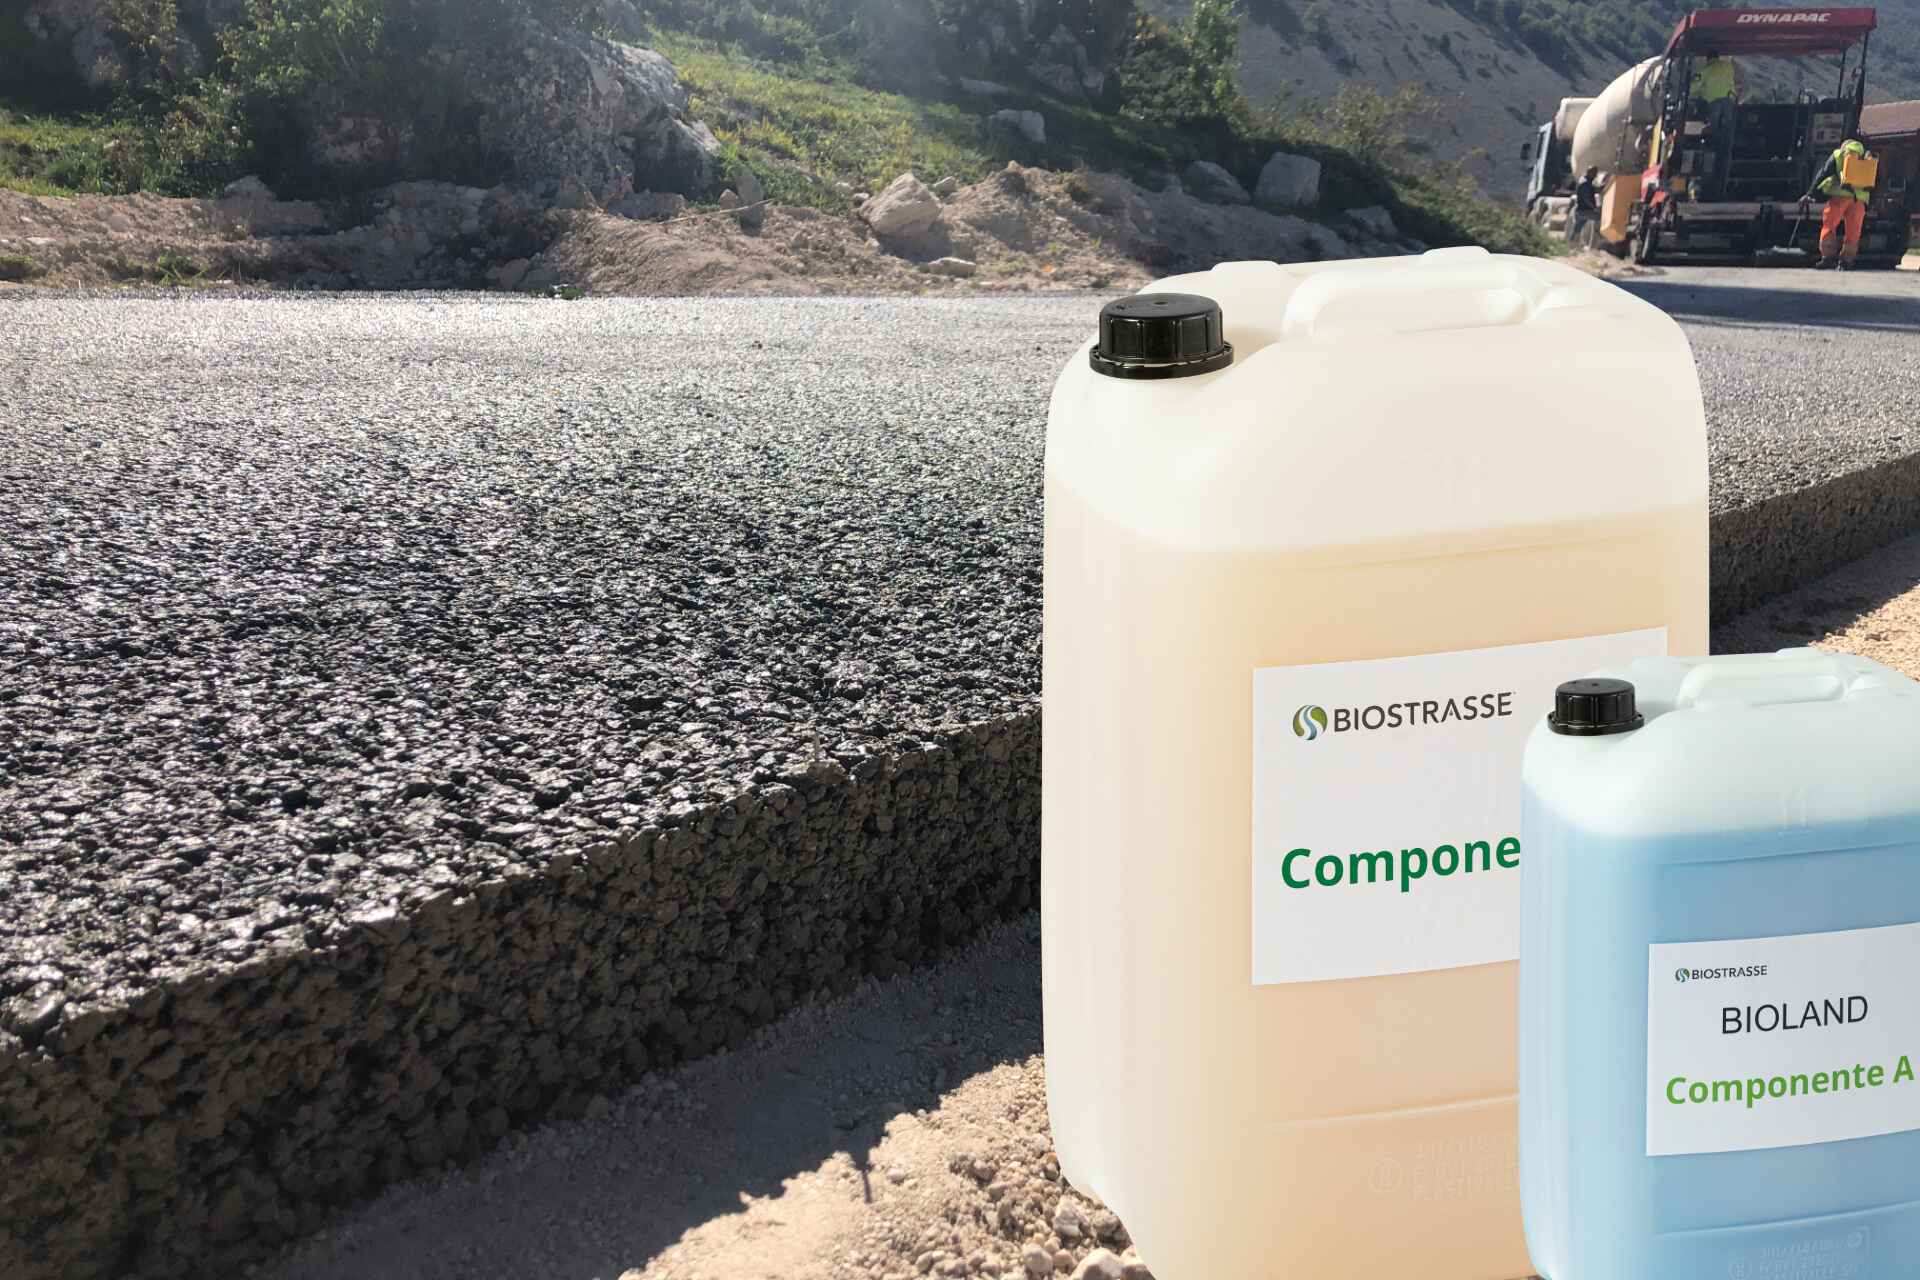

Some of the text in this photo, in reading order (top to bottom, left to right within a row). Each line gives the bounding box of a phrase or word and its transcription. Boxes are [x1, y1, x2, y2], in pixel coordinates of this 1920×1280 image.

[1736, 12, 1831, 23] DYNAPAC
[1334, 691, 1513, 733] BIOSTRASSE
[1281, 836, 1520, 893] Compone
[1691, 965, 1768, 980] BIOSTRASSE
[1721, 995, 1869, 1035] BIOLAND
[1665, 1055, 1915, 1109] Componente A
